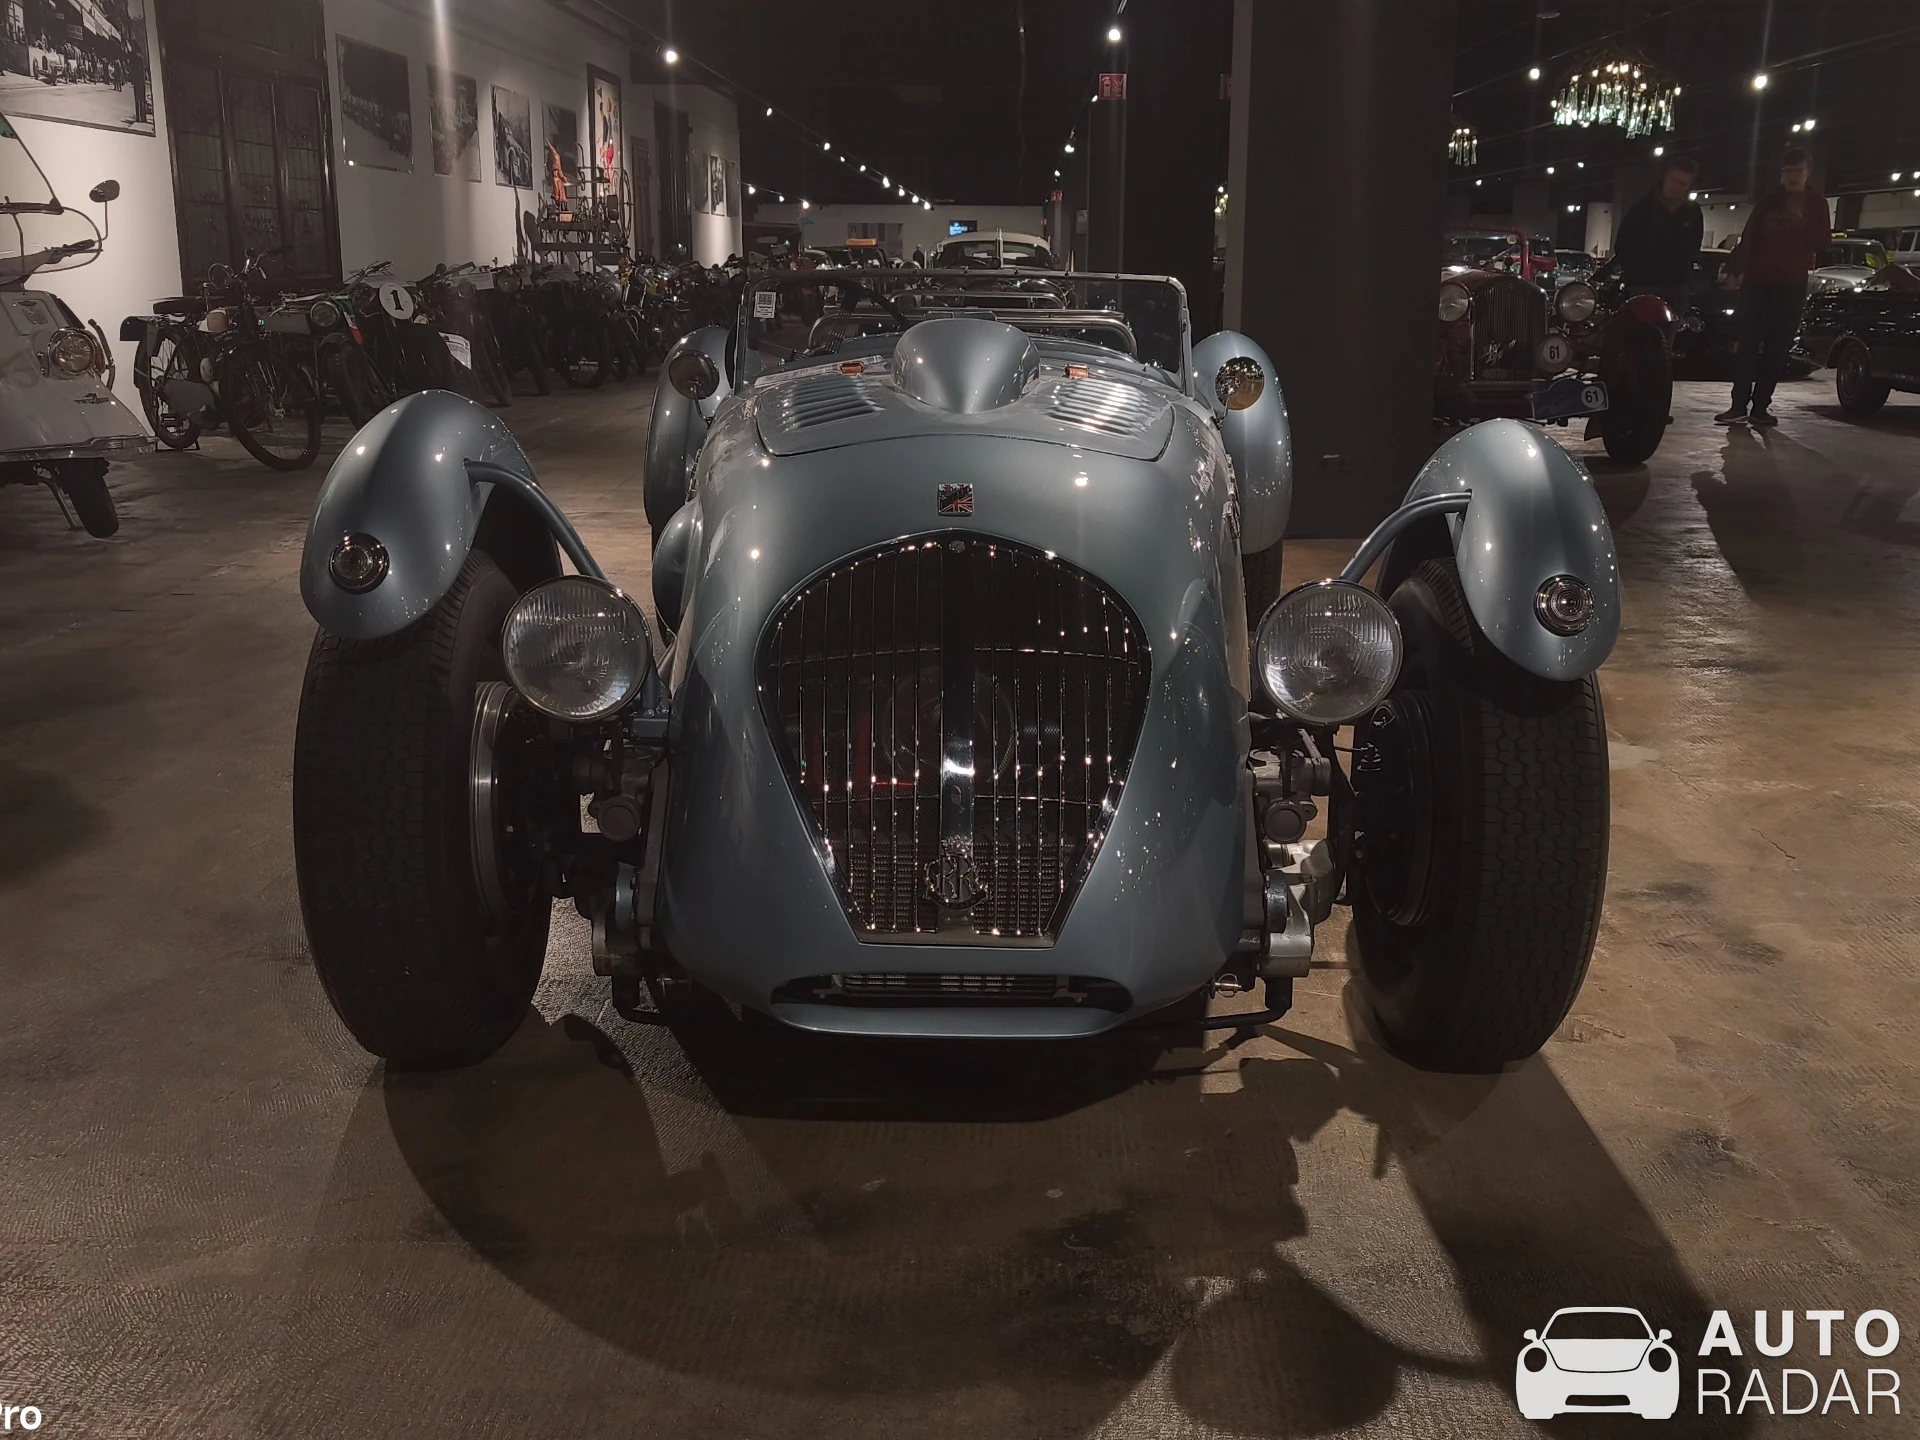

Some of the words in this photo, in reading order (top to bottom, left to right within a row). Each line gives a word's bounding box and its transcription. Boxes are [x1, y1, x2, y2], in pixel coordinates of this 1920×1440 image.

[389, 289, 404, 311] 1
[1549, 344, 1560, 360] 61
[1585, 390, 1599, 403] 61
